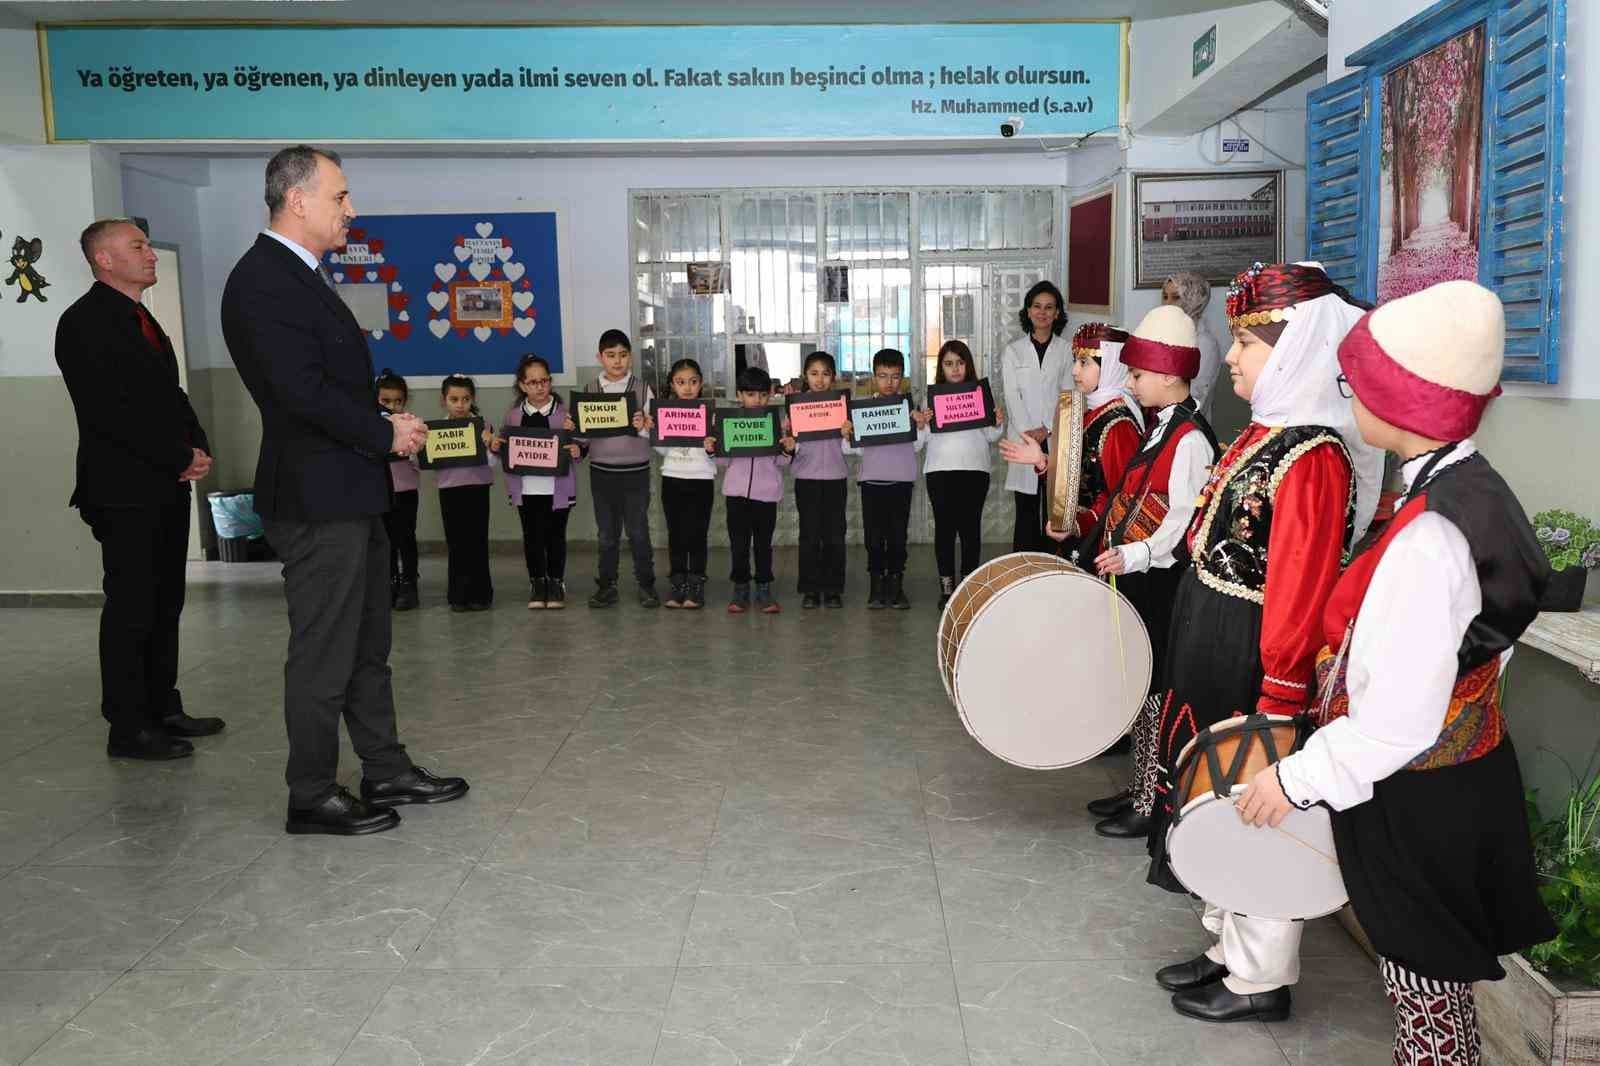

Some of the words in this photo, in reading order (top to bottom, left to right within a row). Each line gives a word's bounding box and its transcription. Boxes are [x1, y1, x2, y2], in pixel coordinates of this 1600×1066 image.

[76, 69, 103, 88] Ya
[107, 66, 199, 92] öğreten,
[203, 72, 229, 92] ya
[233, 65, 329, 92] öğrenen,
[333, 72, 359, 92] ya
[364, 66, 457, 92] dinleyen
[462, 68, 514, 92] yada
[519, 66, 559, 87] ilmi
[564, 73, 627, 88] seven
[632, 68, 659, 87] ol.
[664, 68, 722, 87] Fakat
[727, 67, 785, 86] sakın
[790, 65, 866, 92] beşinci
[871, 67, 923, 85] olma
[929, 71, 935, 88] ;
[940, 65, 1000, 85] helak
[1004, 65, 1091, 85] olursun.
[911, 99, 937, 114] Hz.
[941, 98, 1040, 114] Muhammed
[1043, 96, 1093, 115] (s.a.v)
[664, 411, 702, 419] ARINMA
[861, 407, 902, 418] RAHMET
[866, 421, 901, 432] AYIDIR.
[437, 430, 465, 439] SABIR
[732, 433, 768, 442] AYIDIR.
[434, 442, 470, 452] AYIDIR.
[515, 438, 554, 449] BEREKET
[517, 451, 552, 460] AYIDIR.
